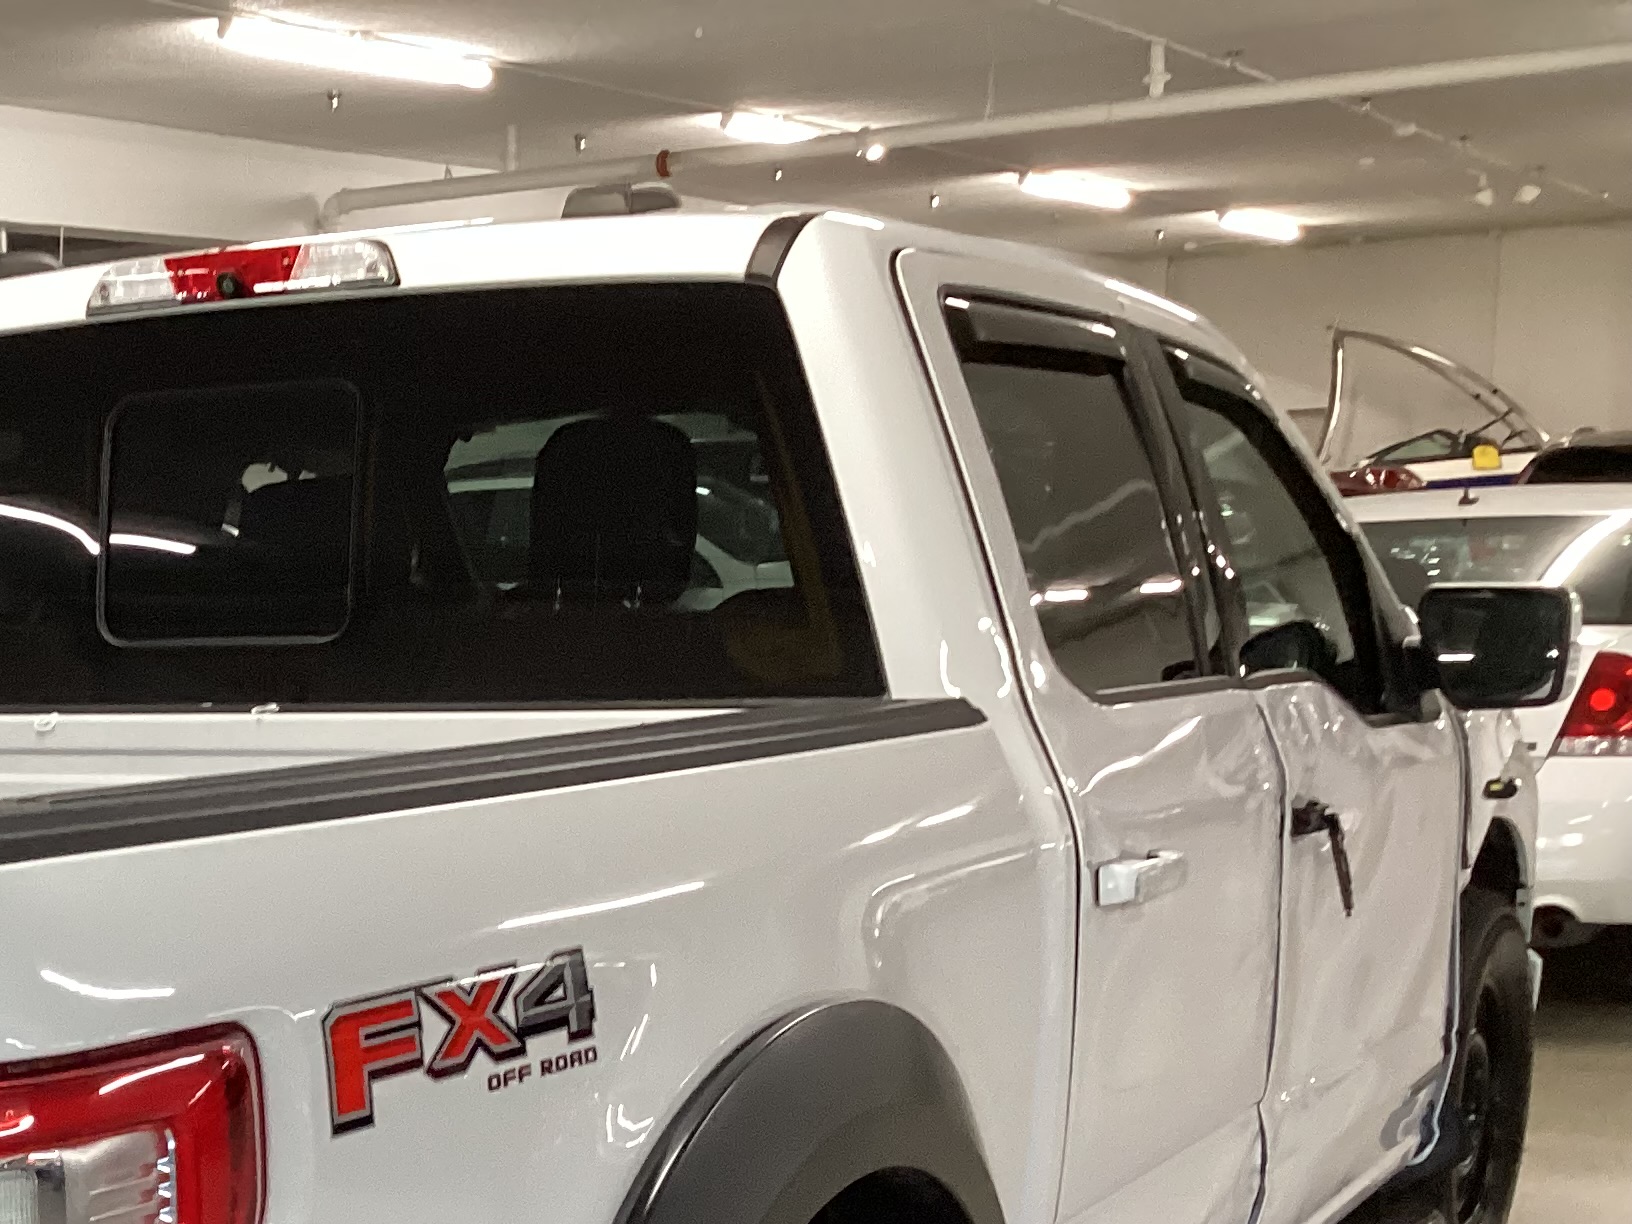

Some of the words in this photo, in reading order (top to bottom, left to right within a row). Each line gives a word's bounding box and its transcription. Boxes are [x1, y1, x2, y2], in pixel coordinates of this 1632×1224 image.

[321, 944, 597, 1138] FX4
[486, 1063, 532, 1092] OFF
[539, 1045, 599, 1078] ROAD
